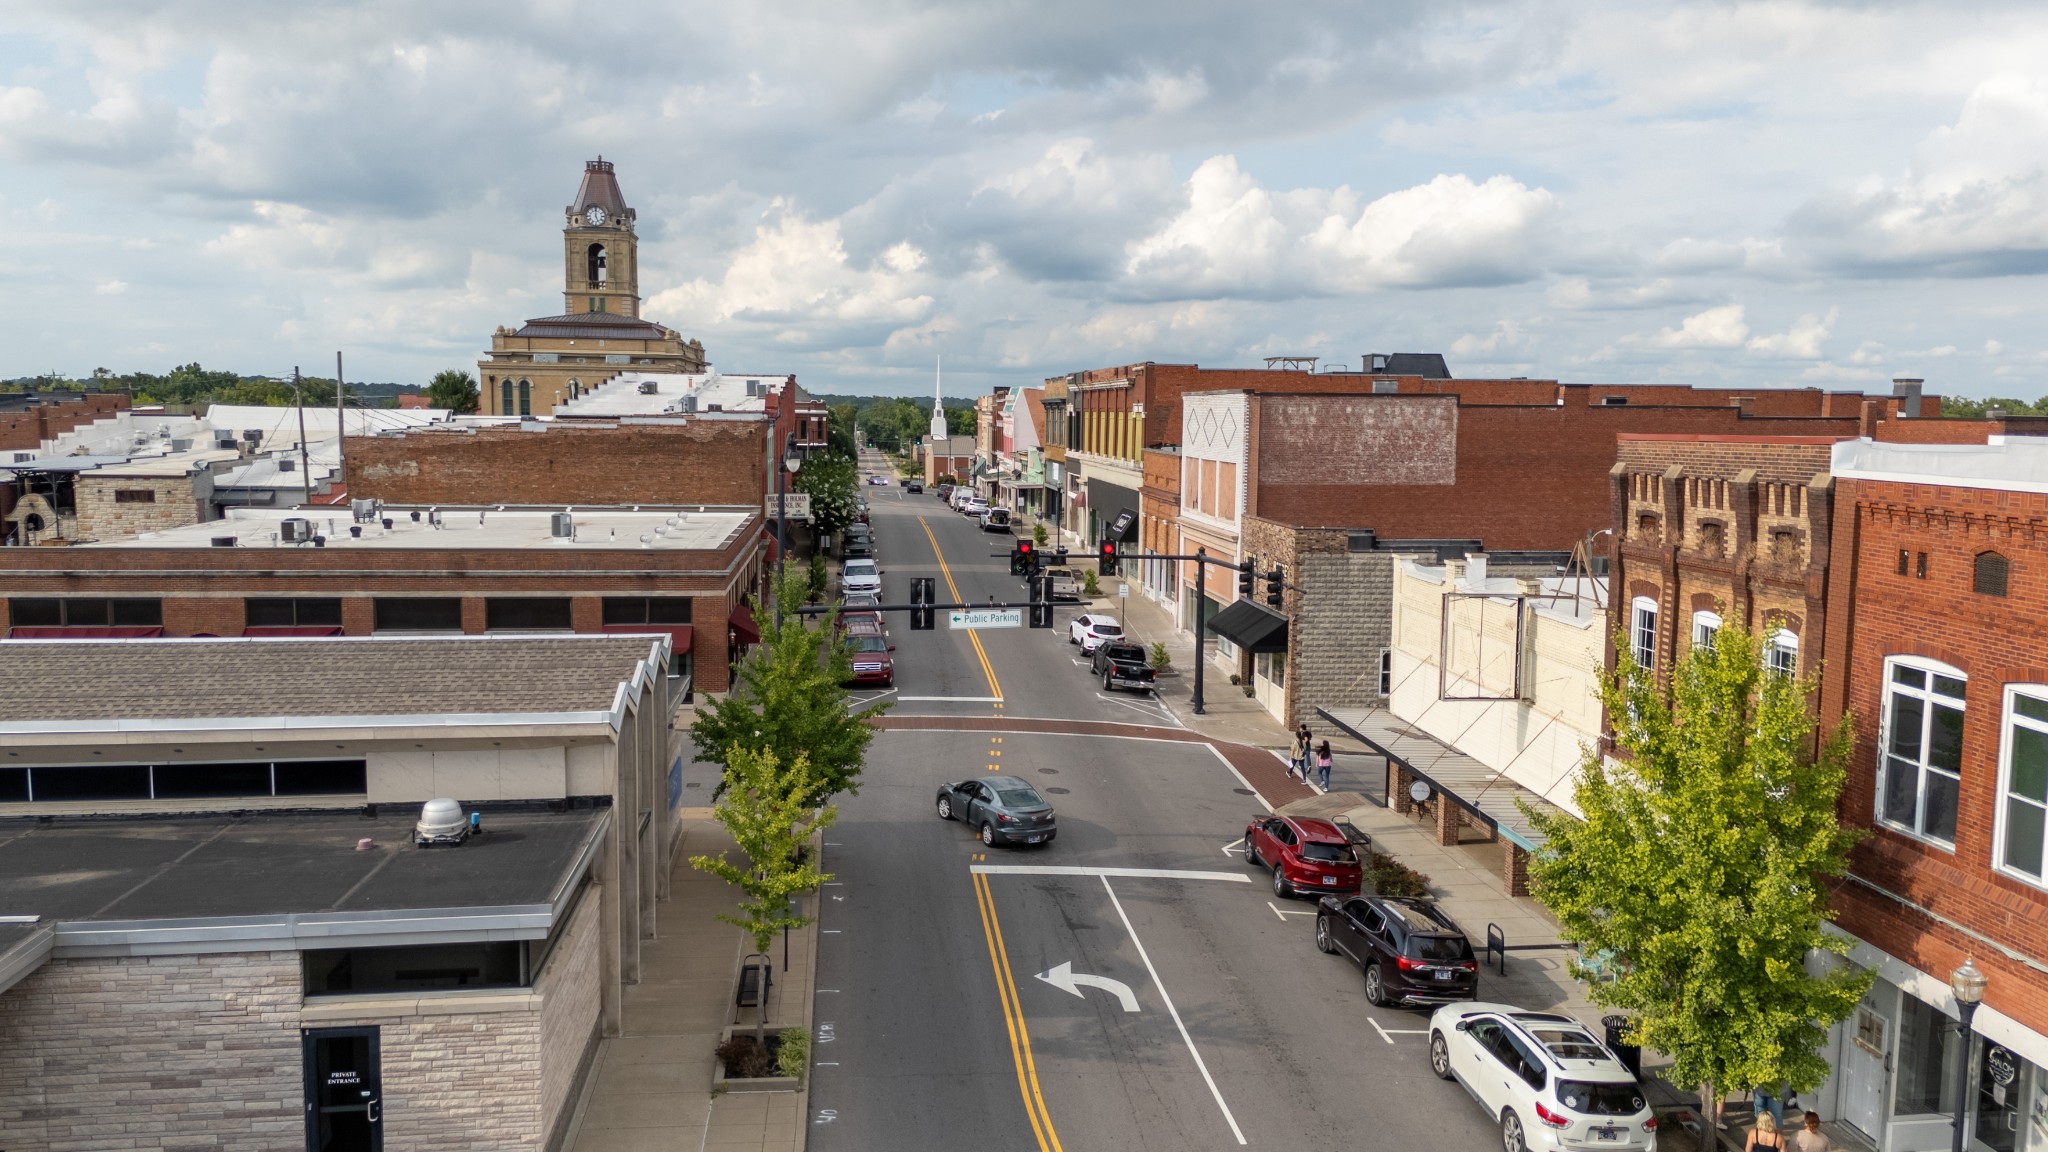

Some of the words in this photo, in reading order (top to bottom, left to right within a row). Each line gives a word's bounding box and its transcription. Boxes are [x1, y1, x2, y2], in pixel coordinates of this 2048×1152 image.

[964, 615, 988, 623] Public
[991, 614, 1019, 624] Parking
[1988, 1055, 2014, 1073] SHALOM
